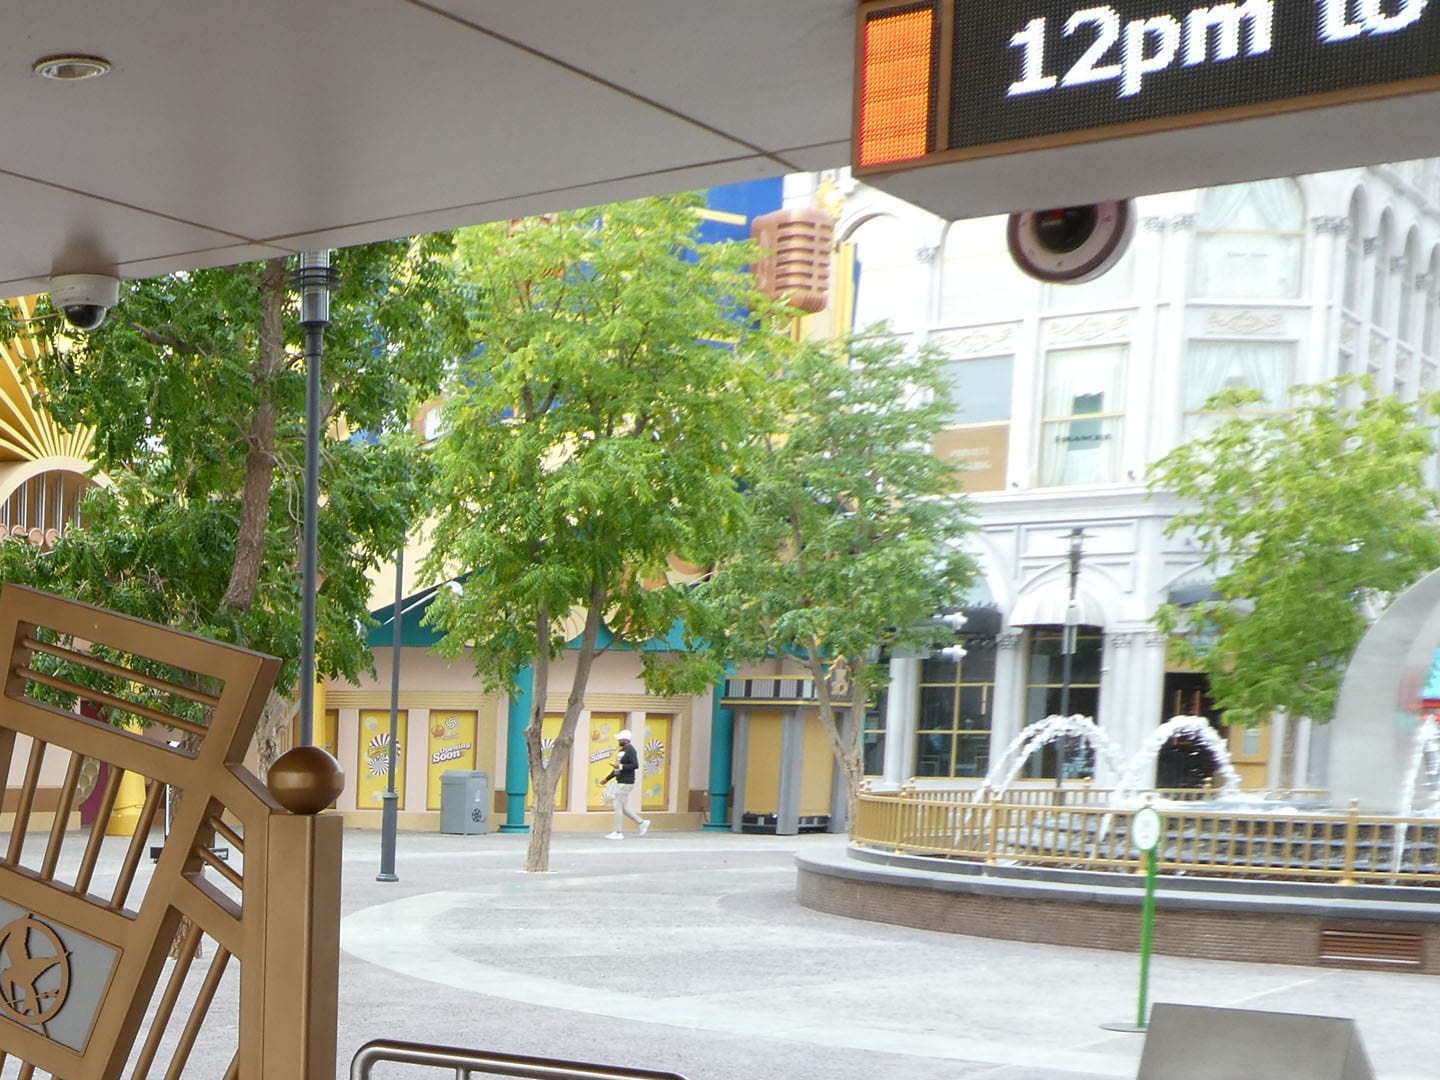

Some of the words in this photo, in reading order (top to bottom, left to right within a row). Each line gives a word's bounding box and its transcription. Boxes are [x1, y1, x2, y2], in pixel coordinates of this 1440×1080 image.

[1006, 0, 1273, 99] 12pm
[440, 743, 471, 753] Opening
[432, 750, 461, 763] Soon
